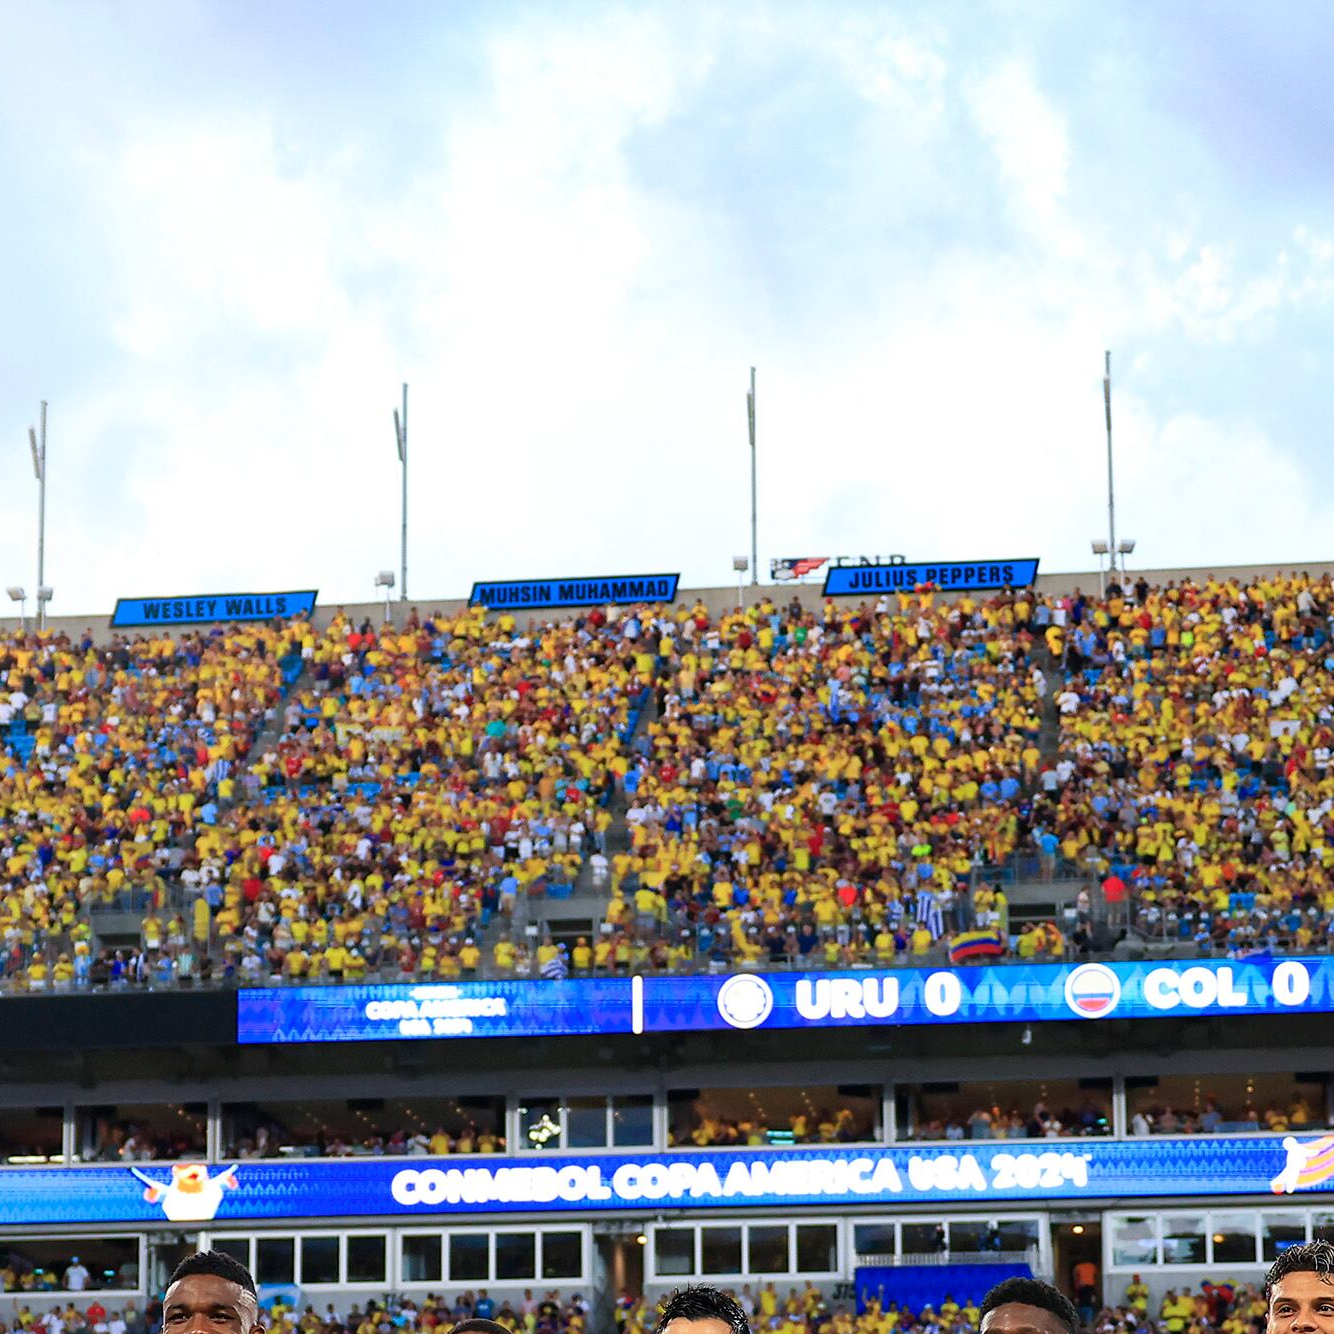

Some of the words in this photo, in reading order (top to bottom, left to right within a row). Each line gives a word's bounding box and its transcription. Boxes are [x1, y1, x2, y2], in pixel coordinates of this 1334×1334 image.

[480, 585, 551, 605] MUHSIN
[559, 579, 668, 601] MUHAMMAD
[850, 571, 916, 589] JULIUS
[925, 565, 1014, 585] PEPPERS
[143, 599, 216, 620] WESLEY
[225, 596, 287, 616] WALLS
[796, 977, 899, 1019] URU
[925, 972, 962, 1015] 0
[1143, 967, 1247, 1009] COL
[1272, 962, 1310, 1005] 0
[391, 1162, 611, 1206] CONMEBOL
[613, 1163, 723, 1199] COPA
[723, 1158, 903, 1196] AMERICA
[908, 1154, 987, 1191] USA
[991, 1152, 1087, 1189] 2024
